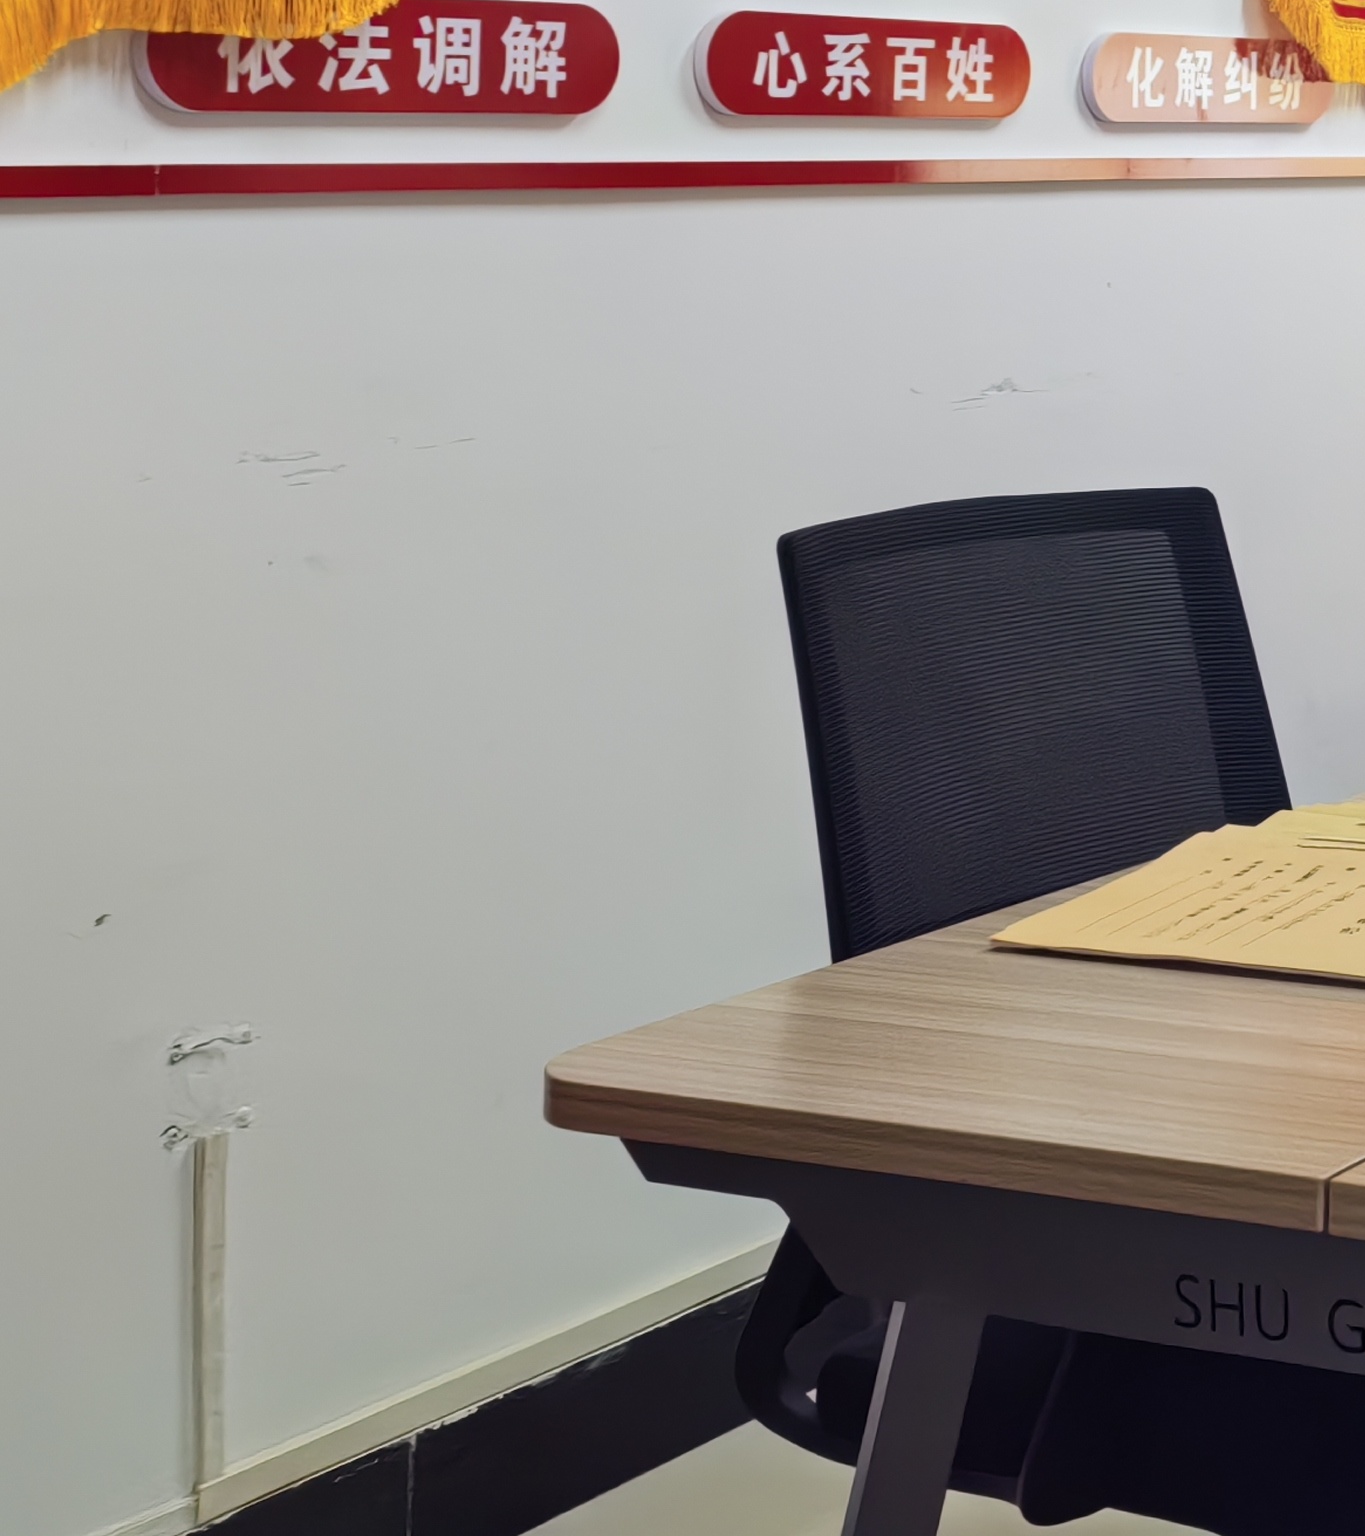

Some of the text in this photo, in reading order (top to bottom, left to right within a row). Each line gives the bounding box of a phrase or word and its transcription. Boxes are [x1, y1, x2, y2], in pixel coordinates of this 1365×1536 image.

[216, 16, 567, 98] 依法调解
[753, 31, 995, 105] 心系百姓
[1127, 45, 1308, 112] 化解纠纷
[1174, 1273, 1290, 1342] SHU
